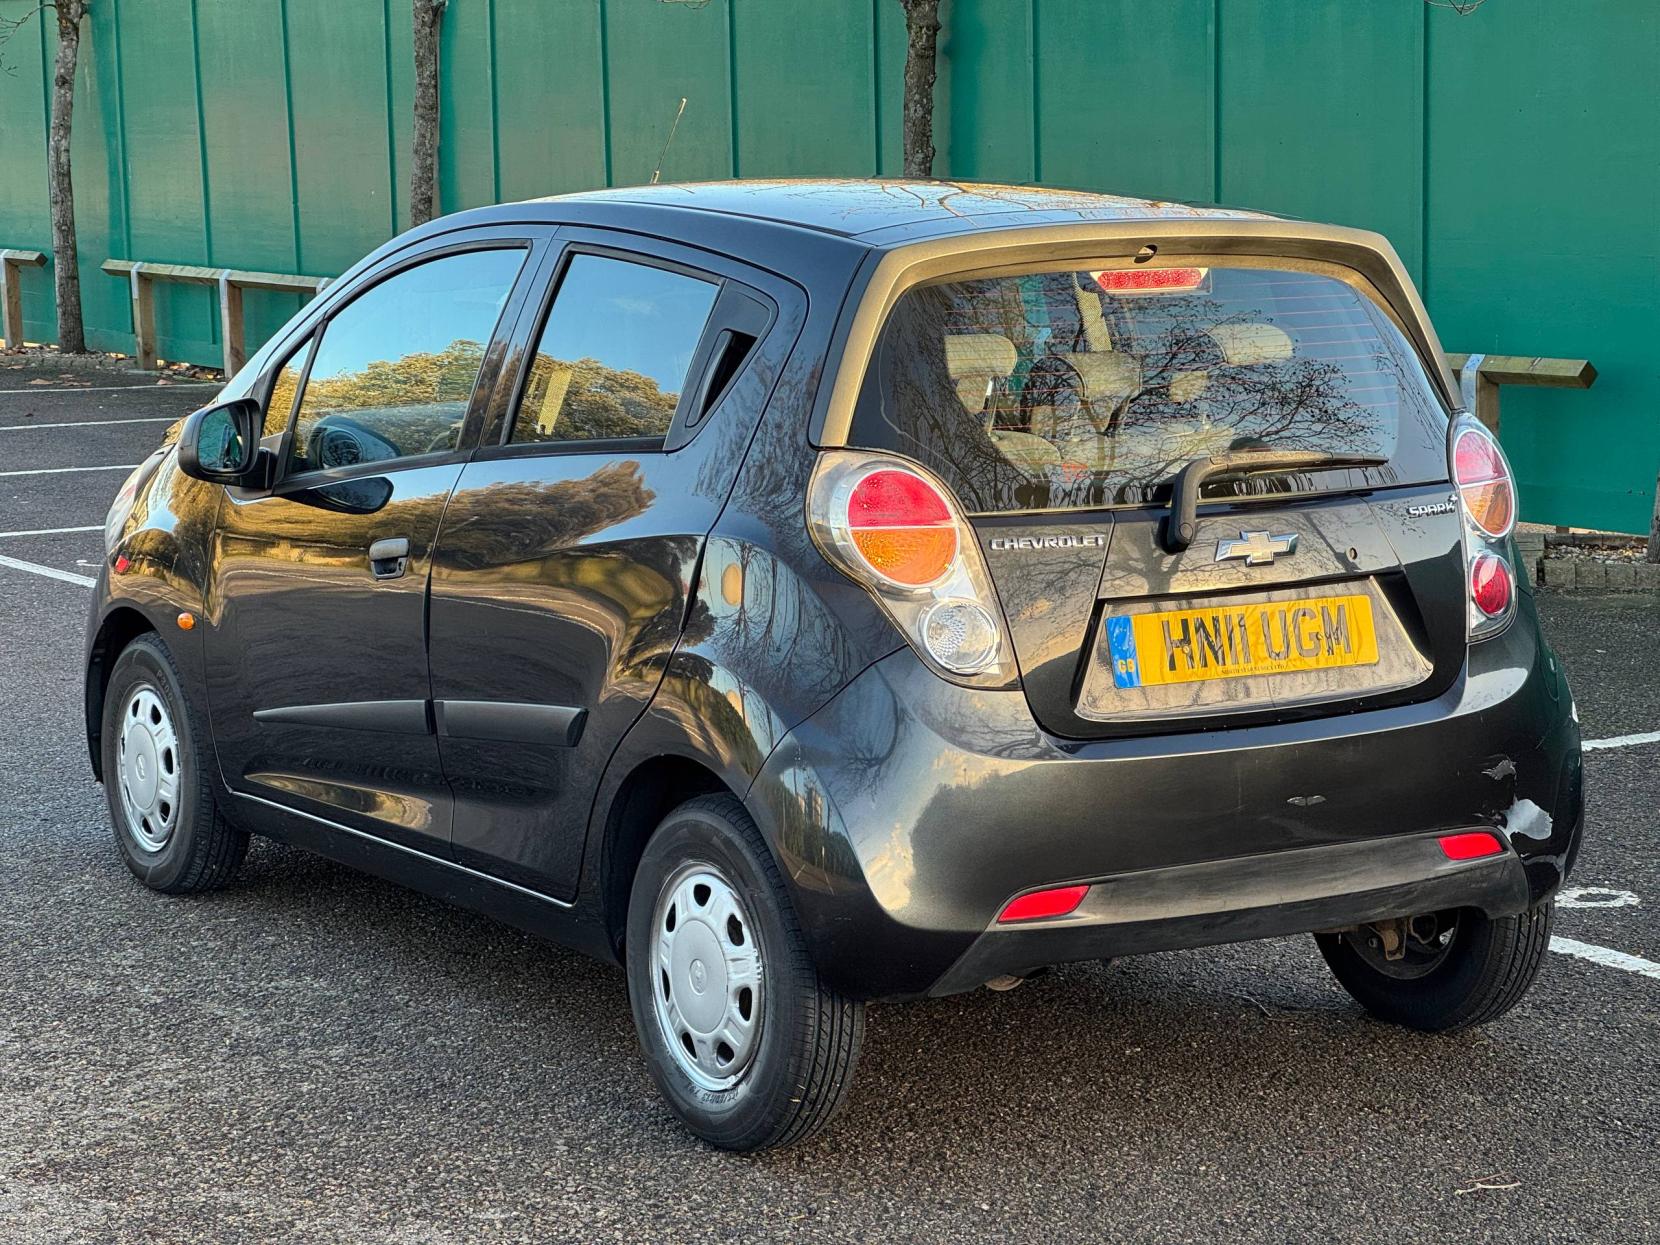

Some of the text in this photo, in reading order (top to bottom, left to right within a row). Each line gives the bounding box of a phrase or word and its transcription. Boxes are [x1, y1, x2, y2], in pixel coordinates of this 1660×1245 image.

[990, 534, 1105, 550] CHEVROLET
[1161, 604, 1352, 671] HN11 UGM
[1117, 658, 1135, 673] GB
